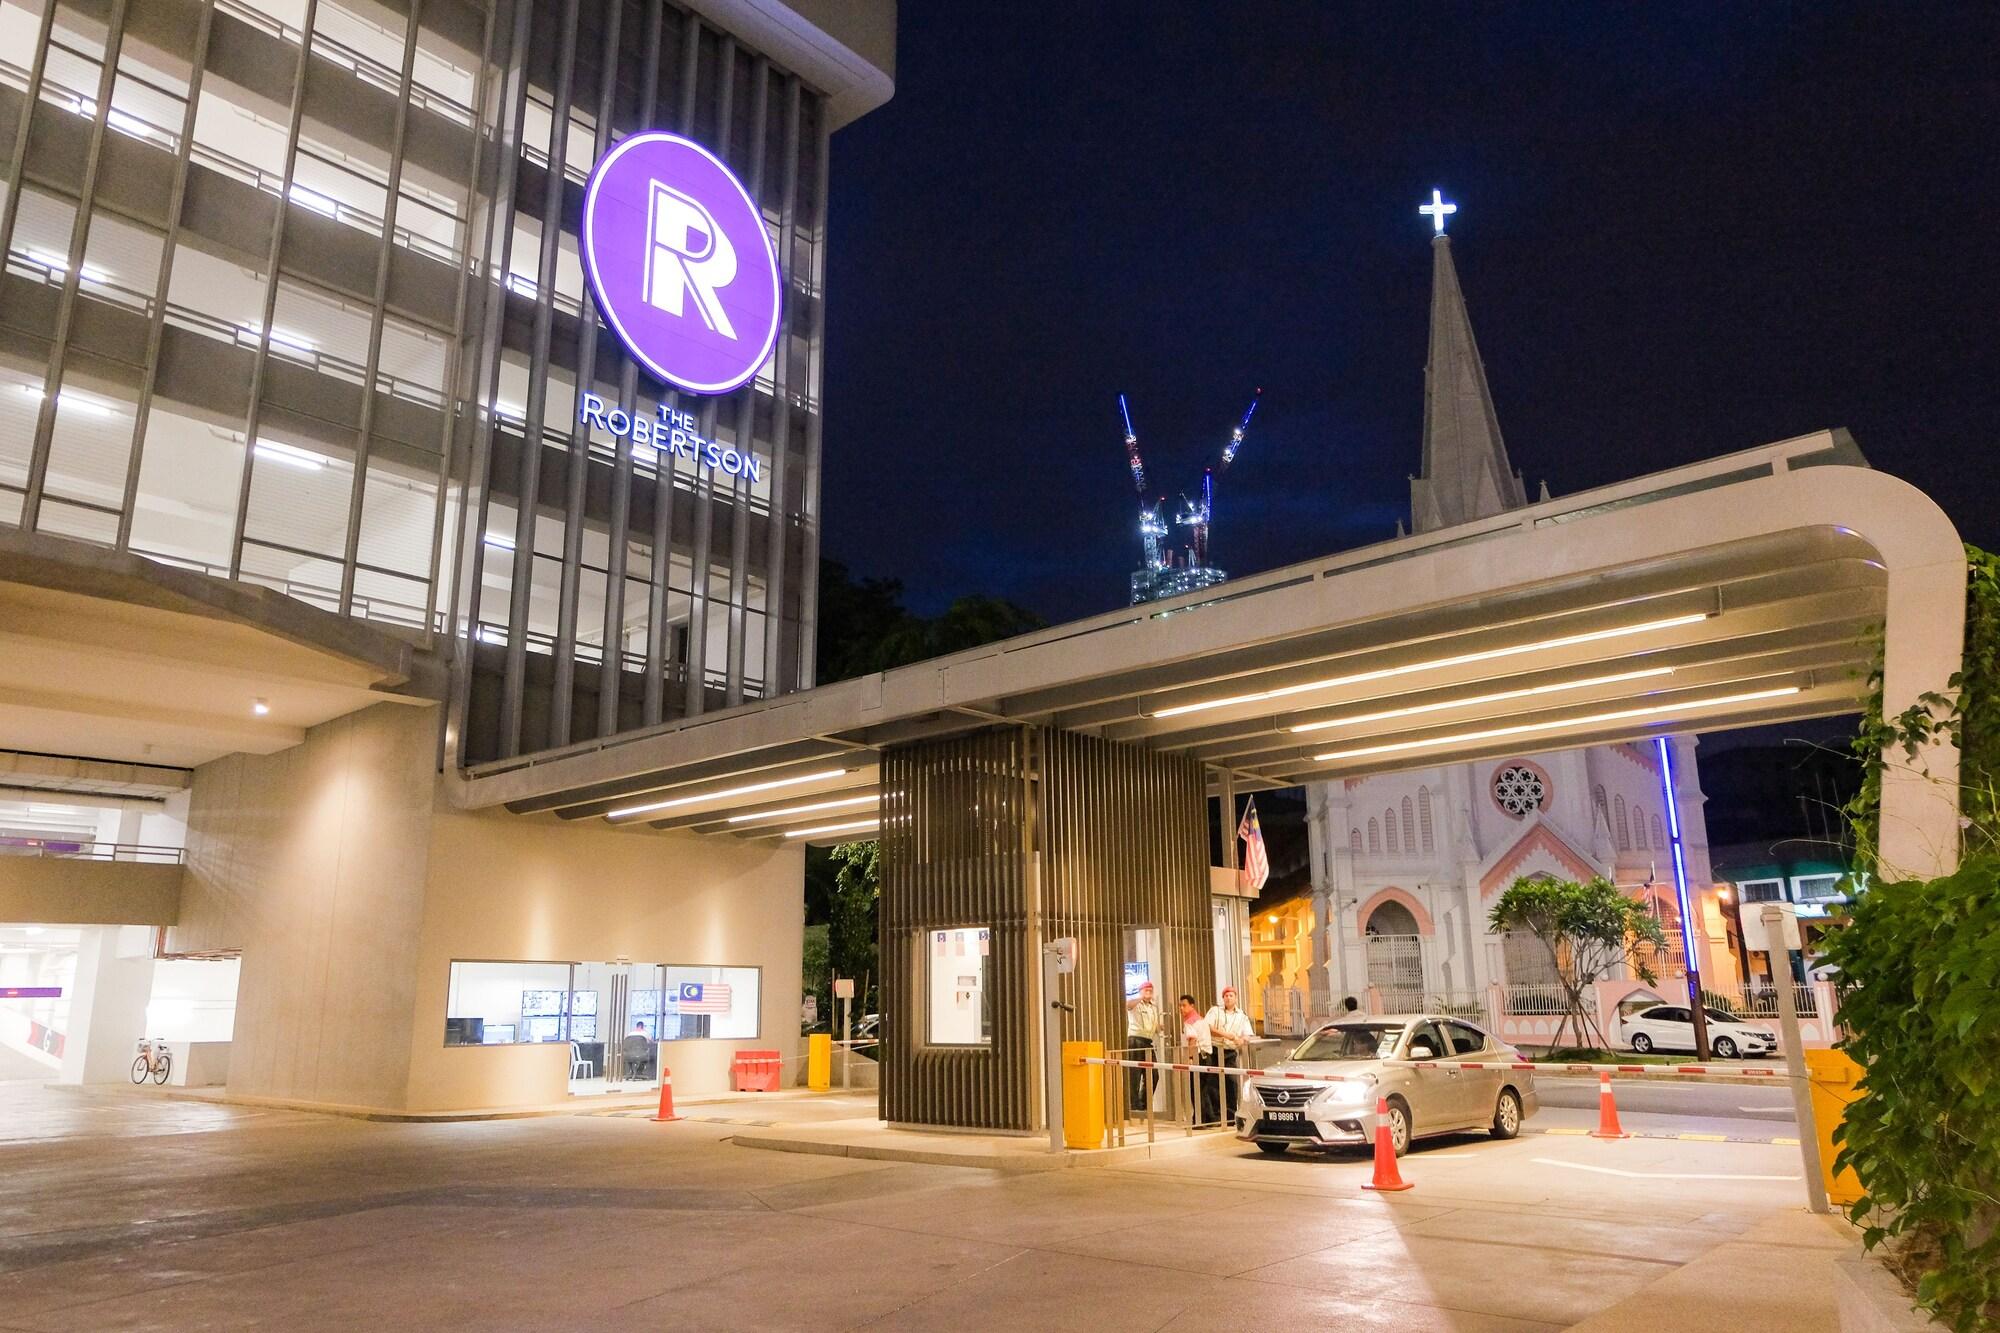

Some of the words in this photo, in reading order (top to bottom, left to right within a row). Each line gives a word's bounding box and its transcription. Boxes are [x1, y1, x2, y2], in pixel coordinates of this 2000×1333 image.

[642, 177, 738, 341] R
[581, 393, 761, 483] ROBERTSON
[659, 404, 694, 432] THE
[1294, 1112, 1300, 1121] Y
